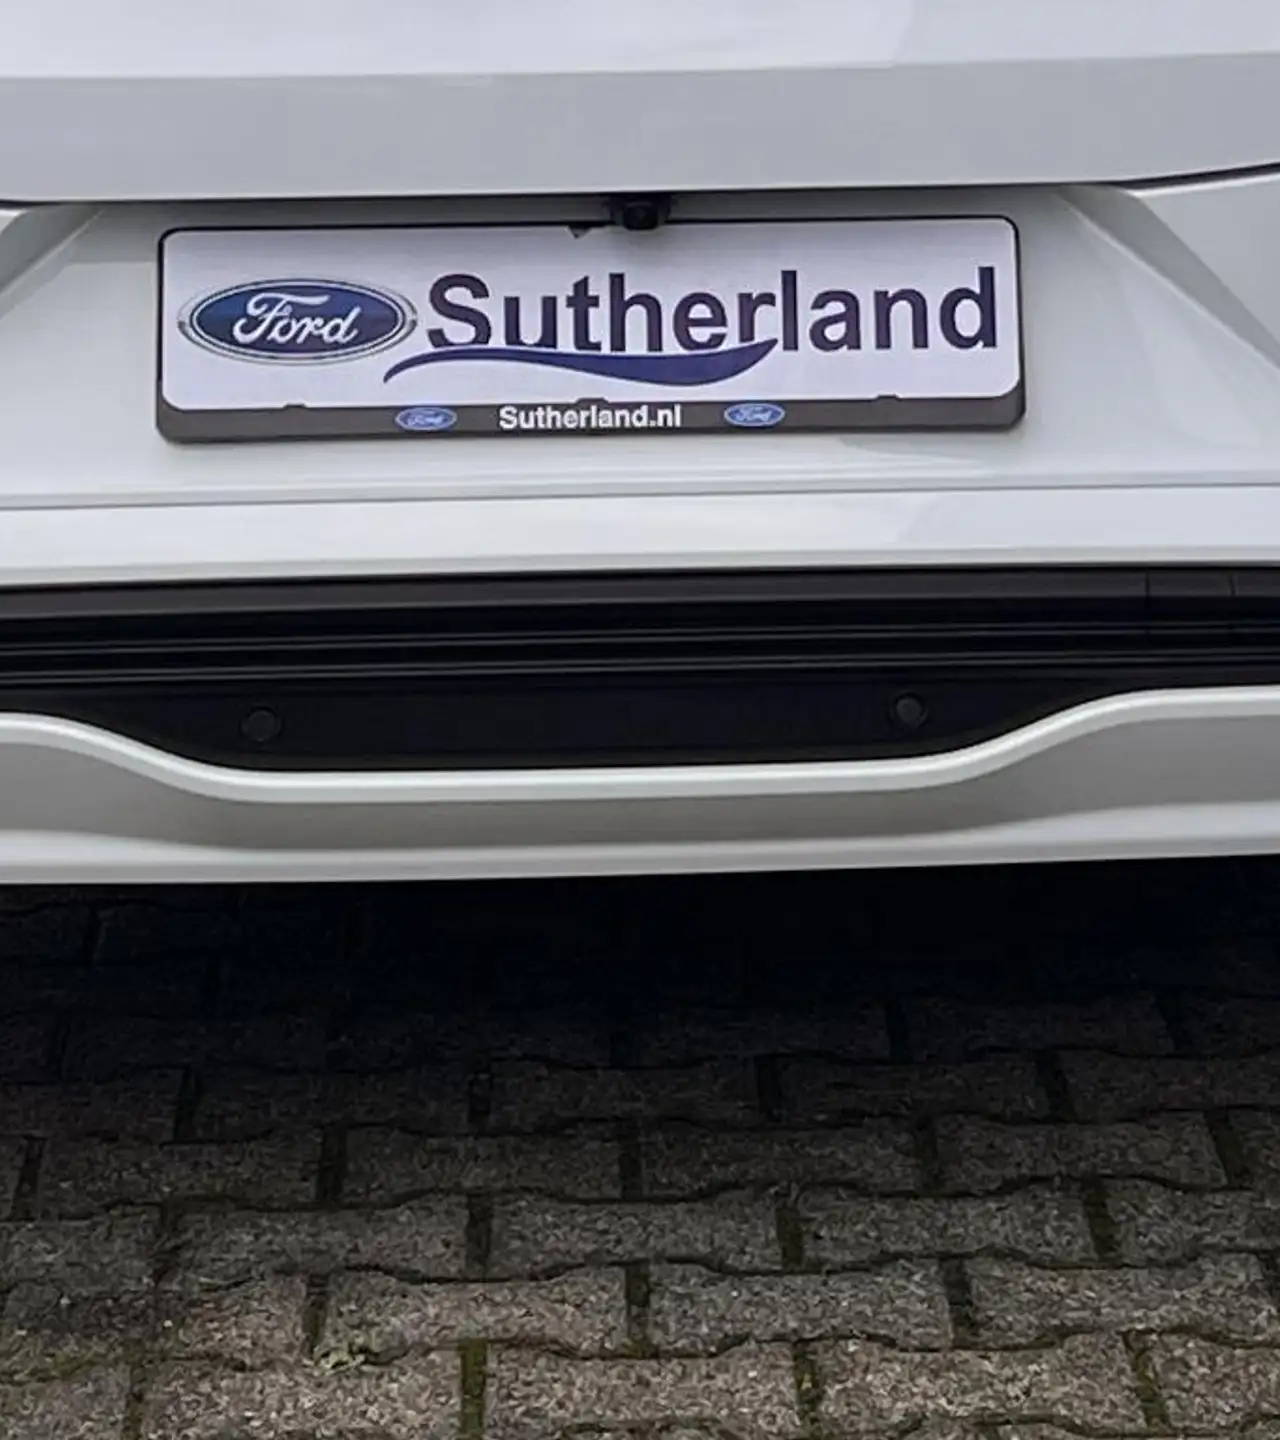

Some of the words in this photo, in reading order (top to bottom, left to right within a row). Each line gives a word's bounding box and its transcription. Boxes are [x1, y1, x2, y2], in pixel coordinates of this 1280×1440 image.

[232, 291, 362, 345] Ford
[426, 265, 998, 353] Sutherland
[499, 404, 682, 430] Sutherland.nl
